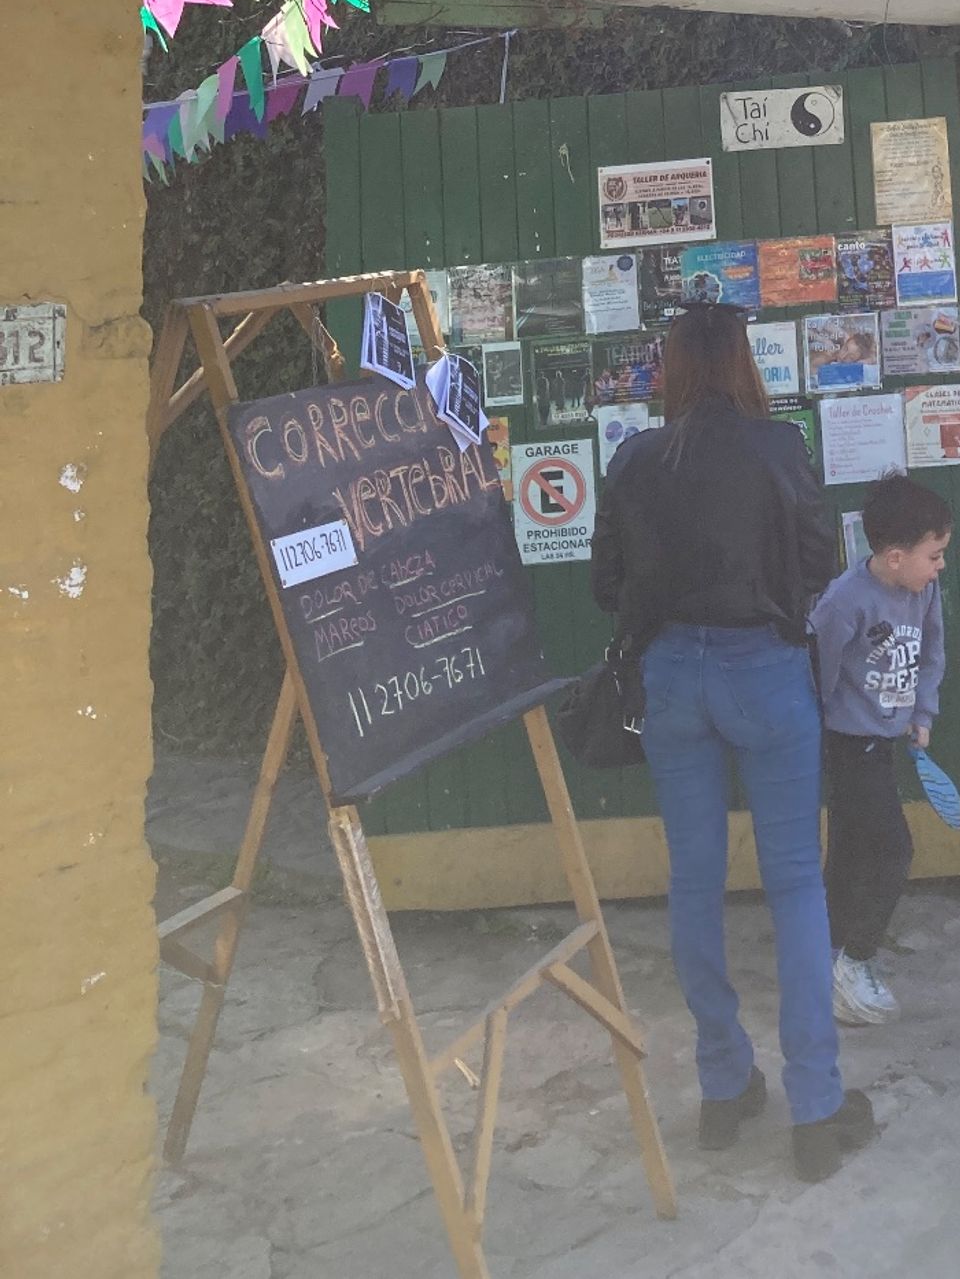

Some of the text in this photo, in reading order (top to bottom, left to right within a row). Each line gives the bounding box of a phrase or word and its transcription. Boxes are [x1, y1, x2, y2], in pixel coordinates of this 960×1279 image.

[633, 175, 658, 185] TALLER
[660, 173, 670, 182] DE
[838, 241, 866, 251] canto
[664, 256, 682, 266] TEAT
[696, 251, 746, 262] ELECTRICIDAD
[749, 336, 785, 356] aller
[764, 366, 792, 383] ORIA
[525, 443, 580, 458] GARAGE
[526, 526, 588, 540] PROHIBIDO
[523, 538, 592, 553] ESTACIONAR
[300, 580, 358, 619] DOLOR
[394, 584, 438, 615] DOLOR
[864, 666, 920, 692] SPEE
